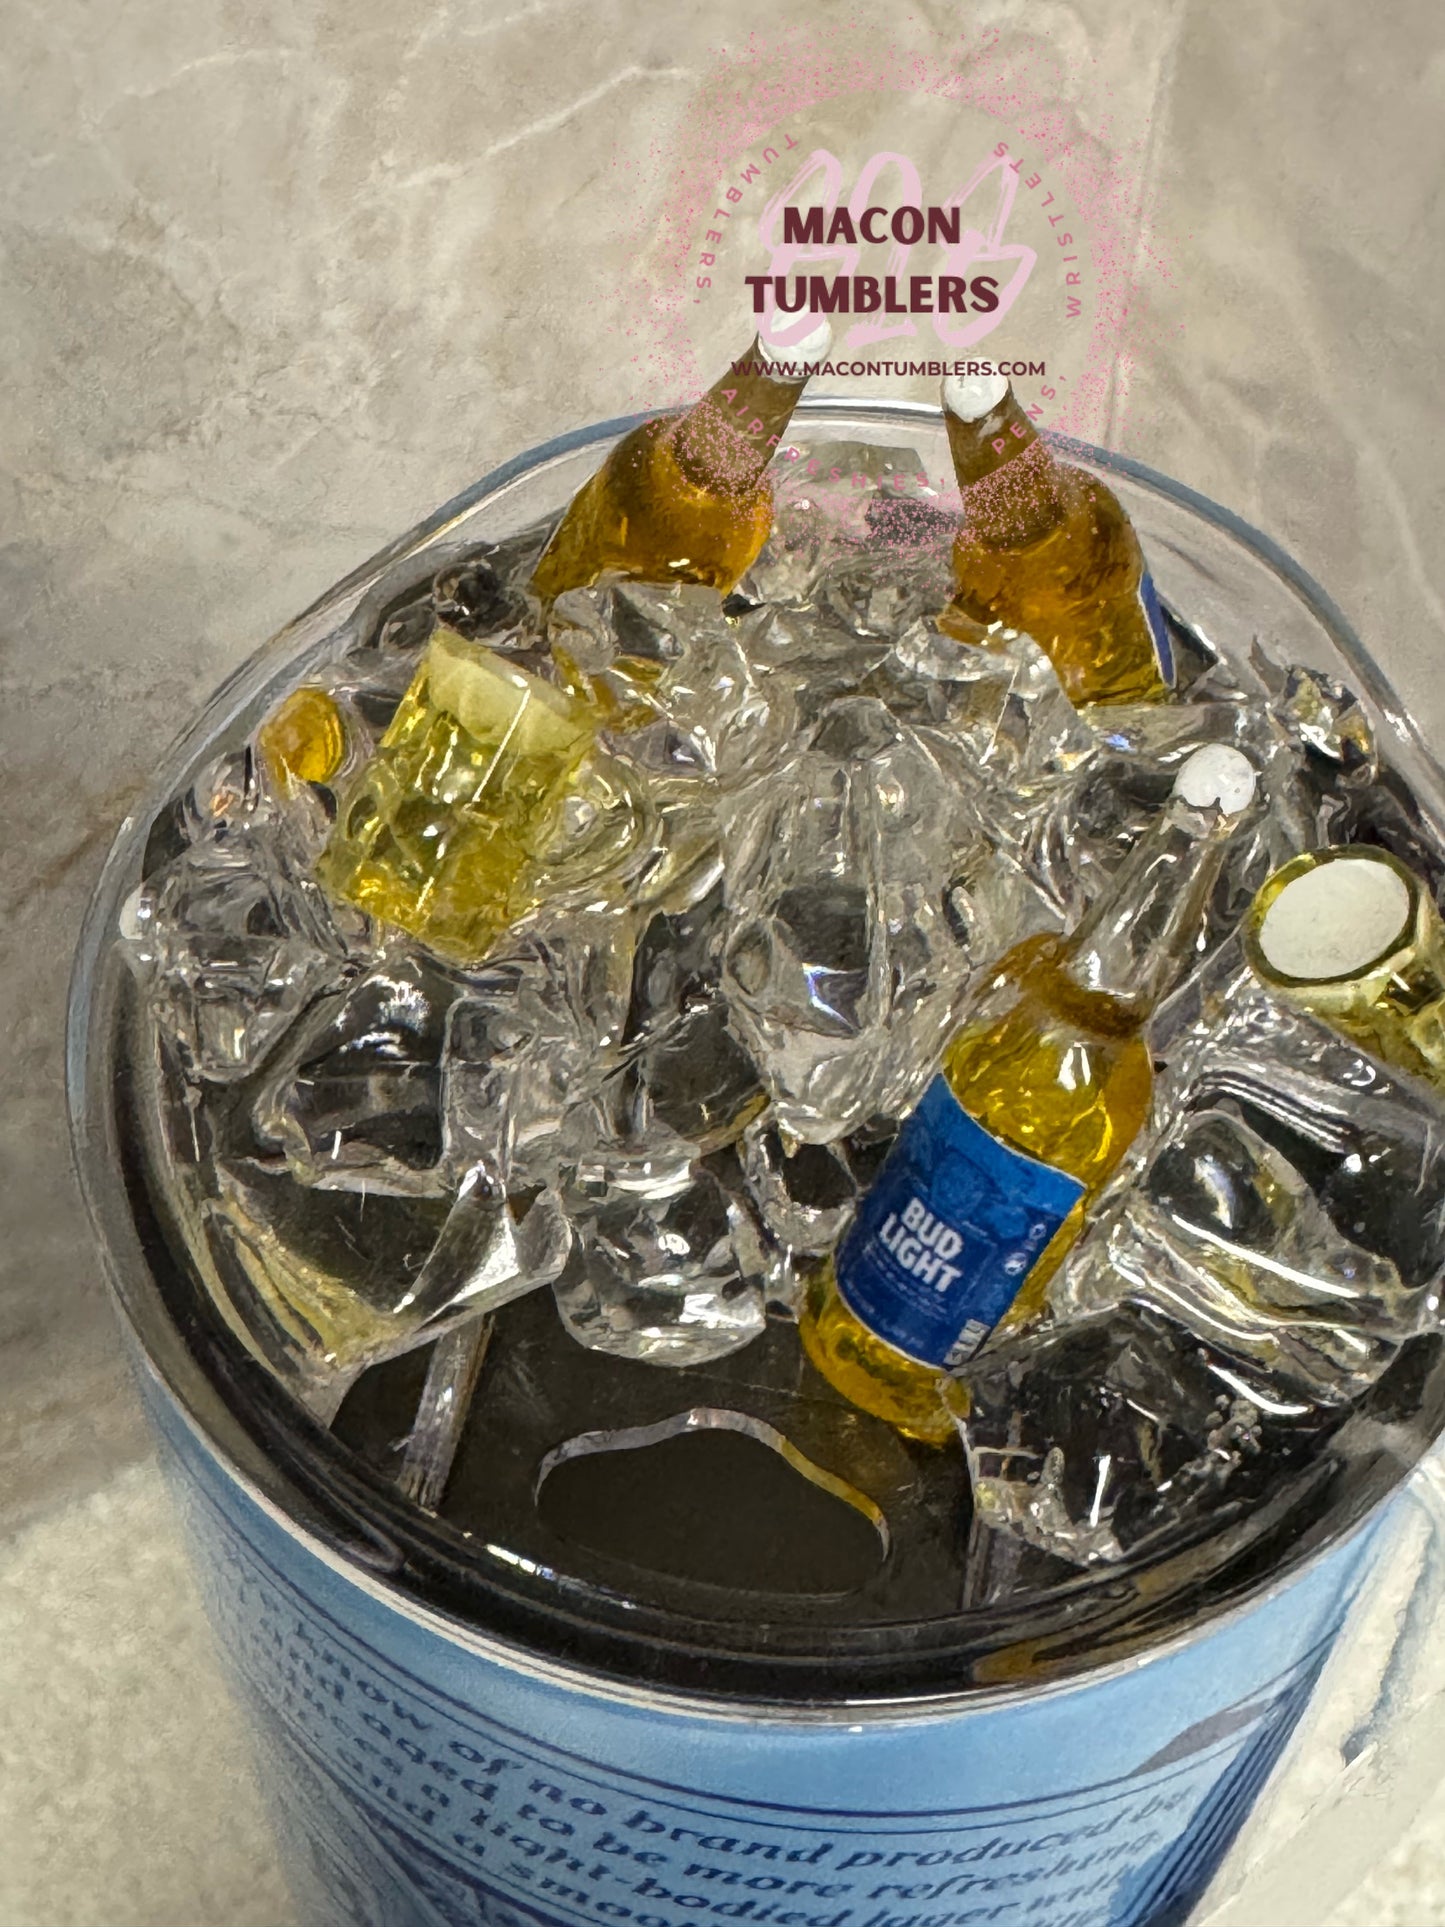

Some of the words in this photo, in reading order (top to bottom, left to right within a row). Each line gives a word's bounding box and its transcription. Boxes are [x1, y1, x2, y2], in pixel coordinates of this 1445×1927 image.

[878, 1211, 964, 1293] LIGHT
[900, 1196, 965, 1261] BUD
[450, 1740, 525, 1776] of
[529, 1778, 607, 1816] no
[621, 1809, 835, 1865] brand
[835, 1806, 1133, 1871] produced
[516, 1803, 577, 1837] to
[592, 1831, 668, 1864] be
[683, 1863, 855, 1899] more
[506, 1861, 722, 1927] smoo
